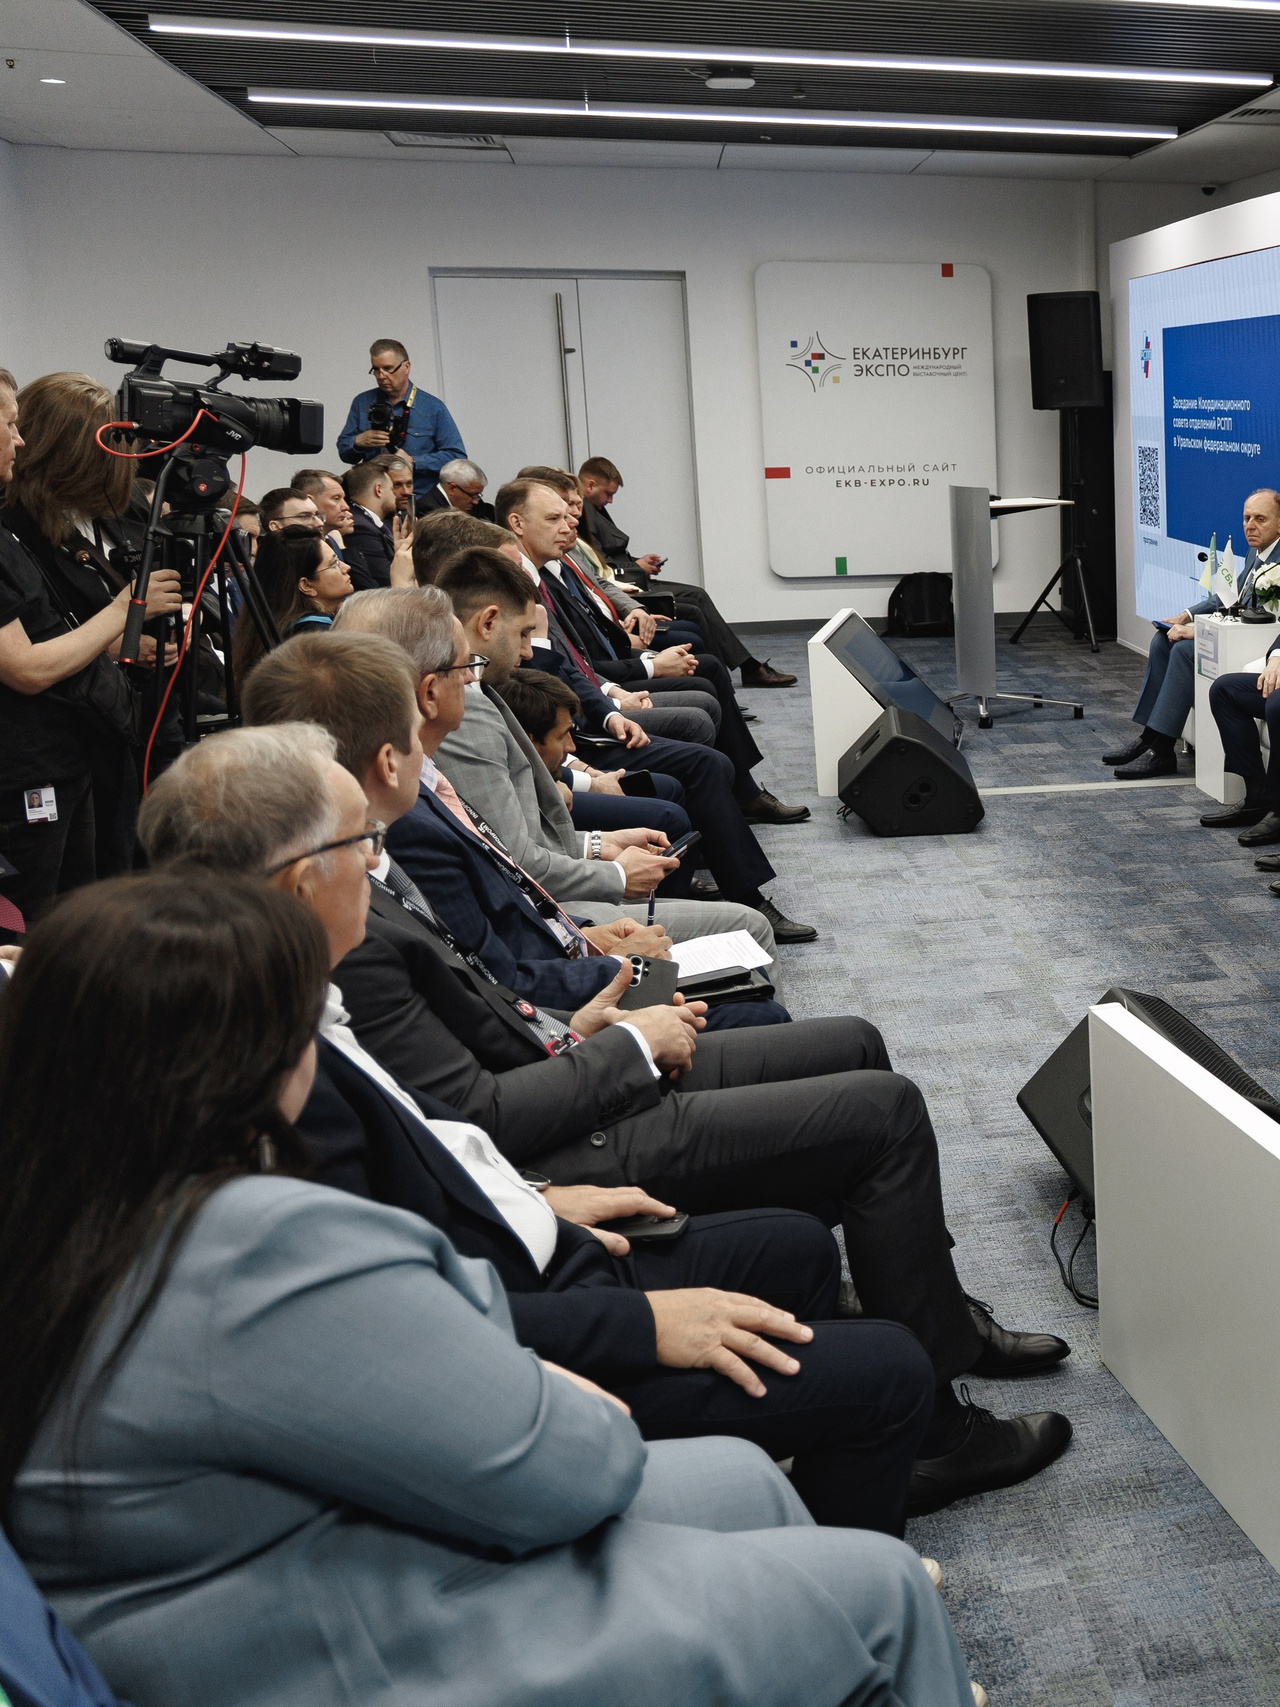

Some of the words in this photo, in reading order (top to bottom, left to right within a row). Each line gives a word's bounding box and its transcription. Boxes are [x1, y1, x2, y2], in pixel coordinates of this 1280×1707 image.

[852, 347, 968, 361] ЕКАТЕРИНБУРГ
[853, 364, 910, 378] ЭКСПО
[1173, 396, 1197, 411] Заседание
[1198, 397, 1251, 412] Координационного
[1173, 418, 1188, 428] совета
[1189, 417, 1216, 430] отделений
[1217, 417, 1232, 431] РСПП
[226, 430, 242, 441] JVC
[1173, 437, 1177, 447] в
[1177, 435, 1203, 450] Уральском
[1204, 436, 1240, 454] федеральном
[1241, 443, 1261, 457] округе
[805, 463, 916, 474] ОФИЦИАЛЬНЫЙ
[923, 462, 958, 473] САЙТ
[836, 478, 930, 488] EKB-EXPO.RU
[1221, 568, 1234, 588] СБЕ
[472, 956, 498, 985] INNOPROM
